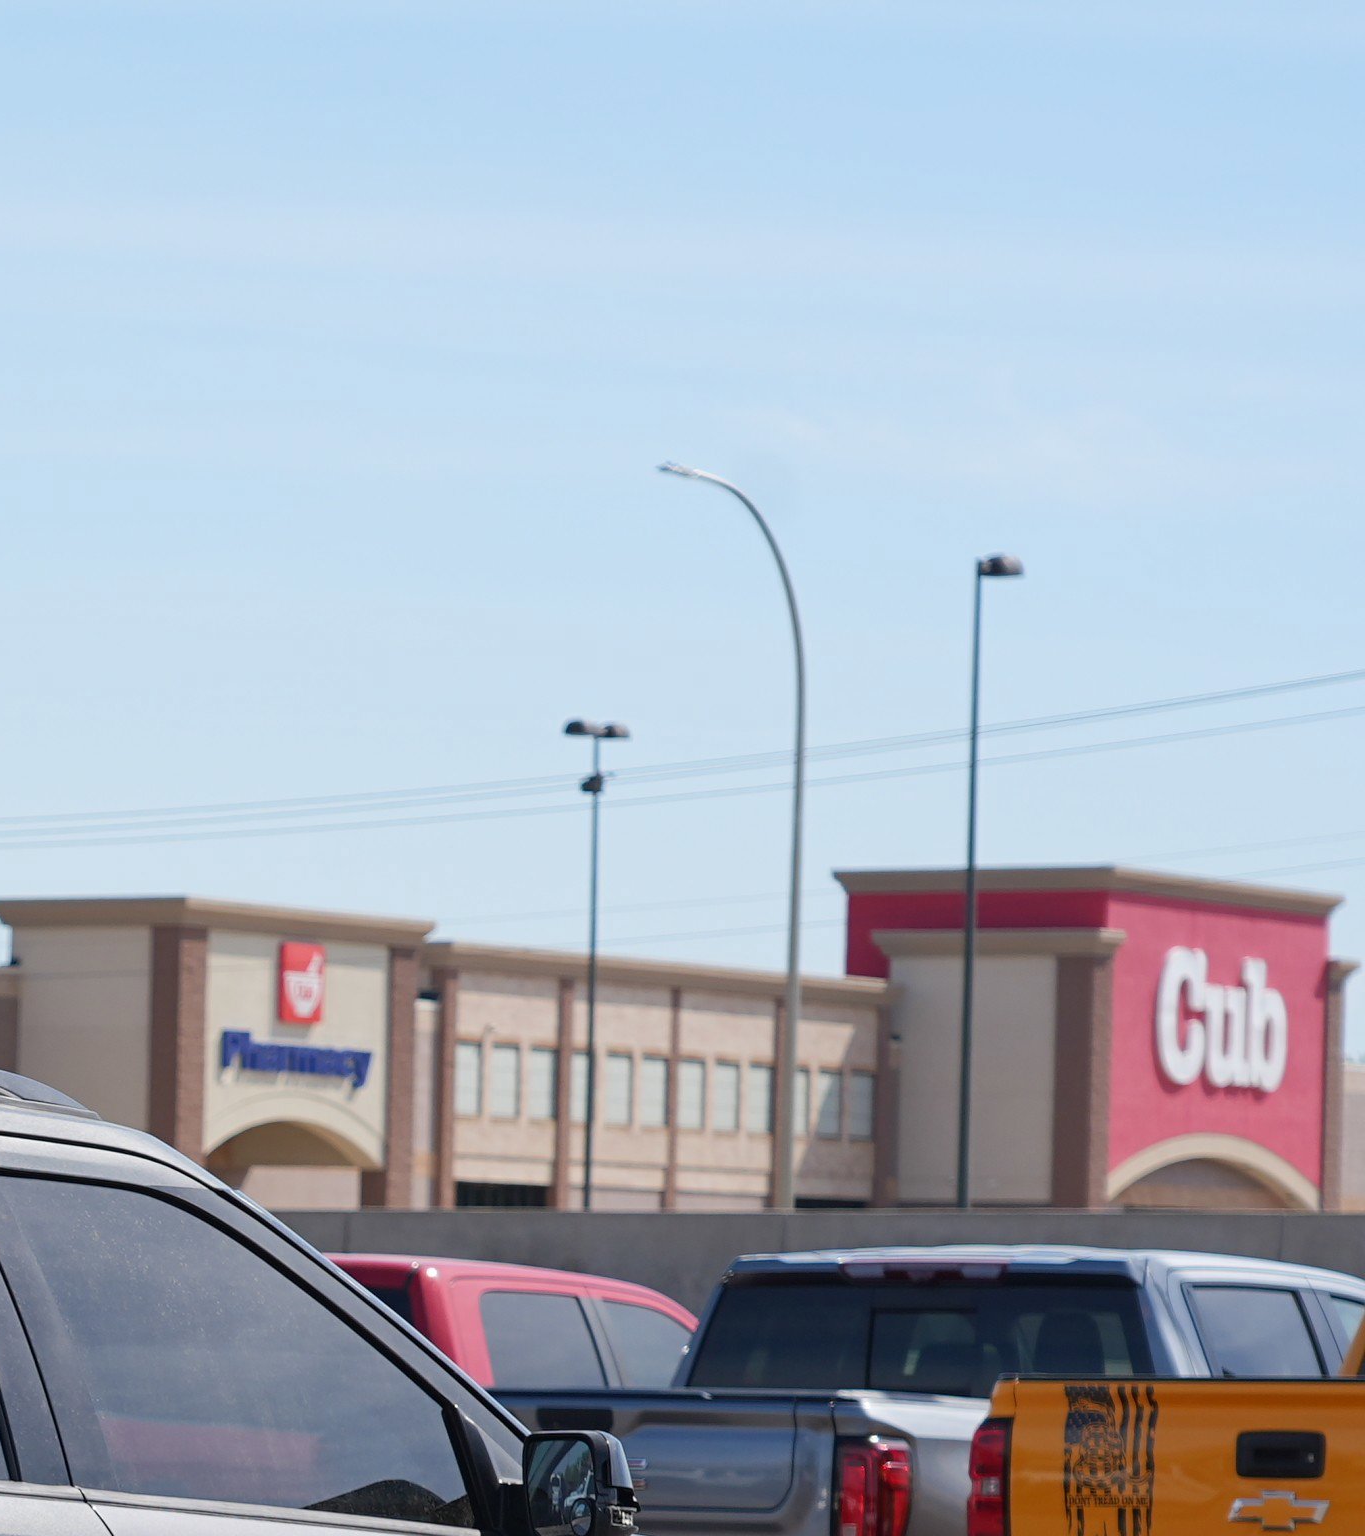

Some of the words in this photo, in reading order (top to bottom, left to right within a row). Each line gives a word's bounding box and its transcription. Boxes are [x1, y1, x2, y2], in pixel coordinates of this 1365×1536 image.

[1155, 945, 1288, 1093] Cub
[222, 1031, 372, 1088] Pharmacy
[1070, 1496, 1090, 1506] DONT
[1095, 1496, 1119, 1506] TREAD
[1122, 1497, 1133, 1506] ON
[1135, 1497, 1148, 1506] ME
